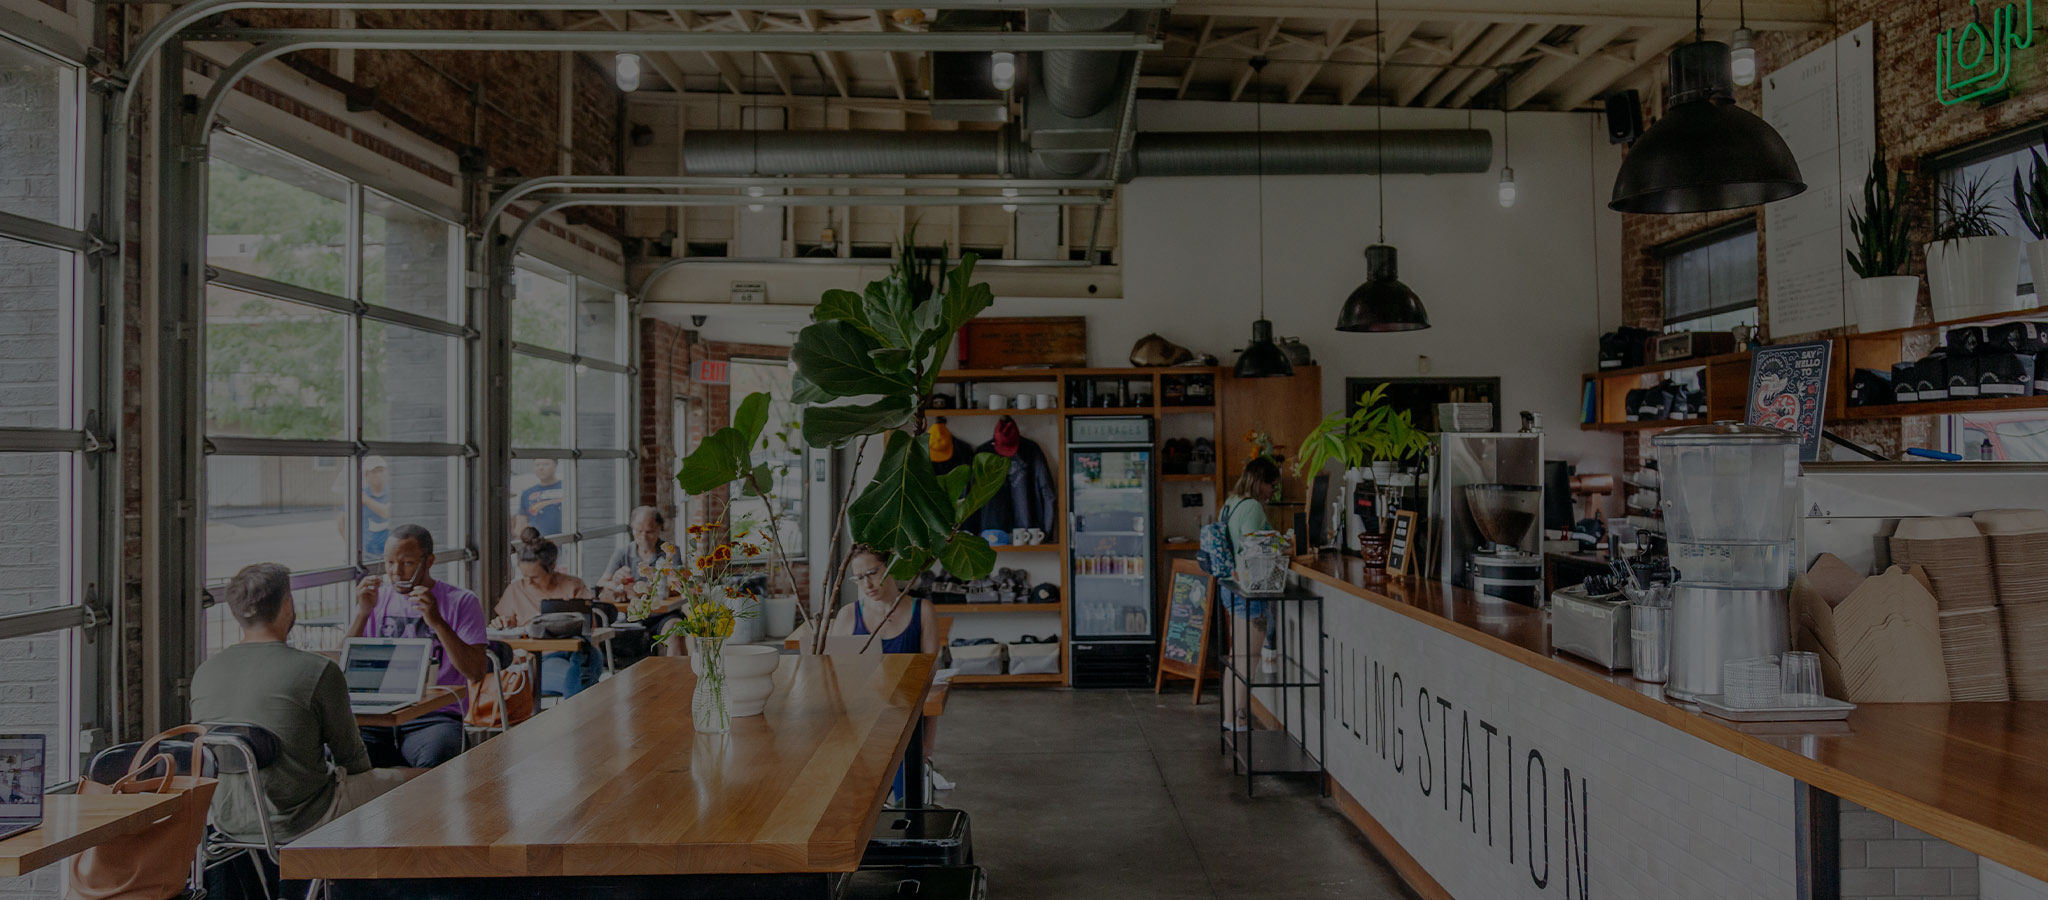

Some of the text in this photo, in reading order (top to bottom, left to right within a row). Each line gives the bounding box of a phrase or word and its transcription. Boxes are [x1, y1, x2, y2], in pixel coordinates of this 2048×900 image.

[1801, 350, 1816, 359] SAY
[1795, 359, 1820, 368] HELLO
[702, 361, 727, 382] EXIT
[1801, 368, 1812, 376] TO
[1418, 686, 1589, 900] STATION
